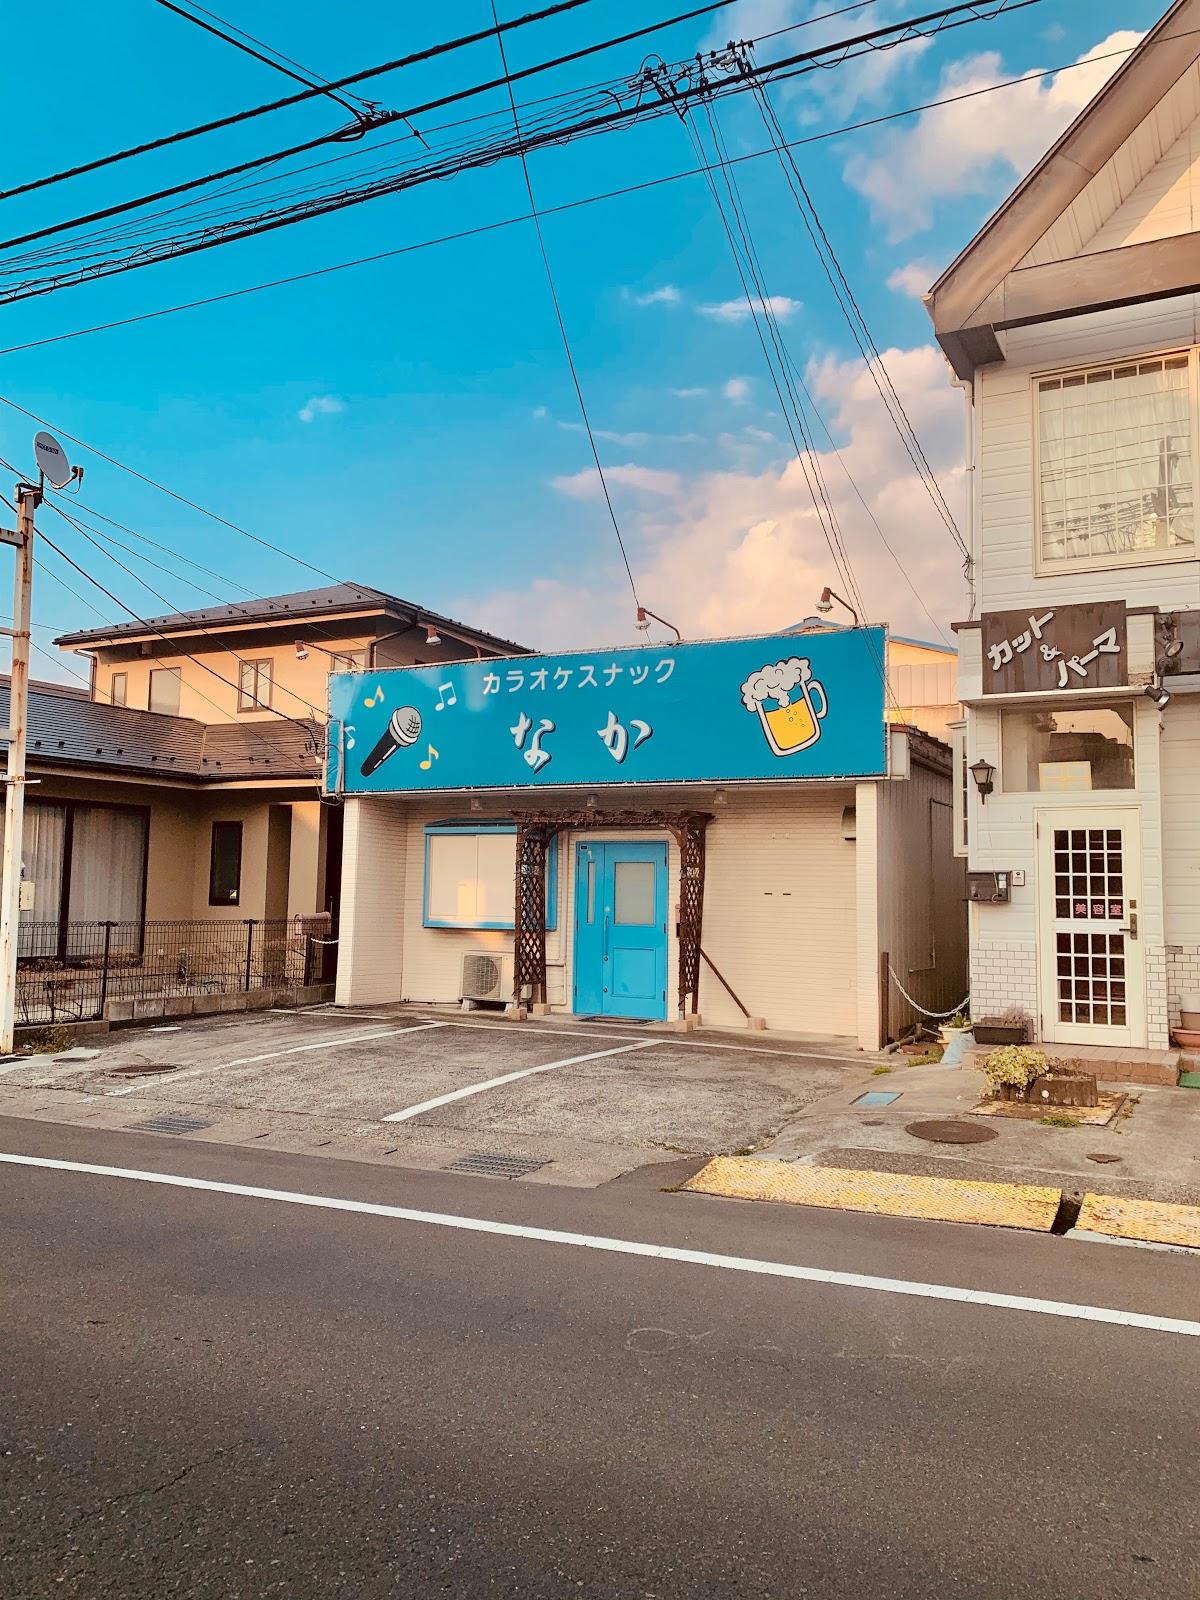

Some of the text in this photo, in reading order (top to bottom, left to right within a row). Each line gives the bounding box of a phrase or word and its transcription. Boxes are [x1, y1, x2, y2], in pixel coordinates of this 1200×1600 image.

[987, 611, 1121, 688] カット & パーマ
[482, 659, 675, 695] カラオケスナック
[510, 710, 653, 773] なか
[1075, 903, 1122, 915] 美容室
